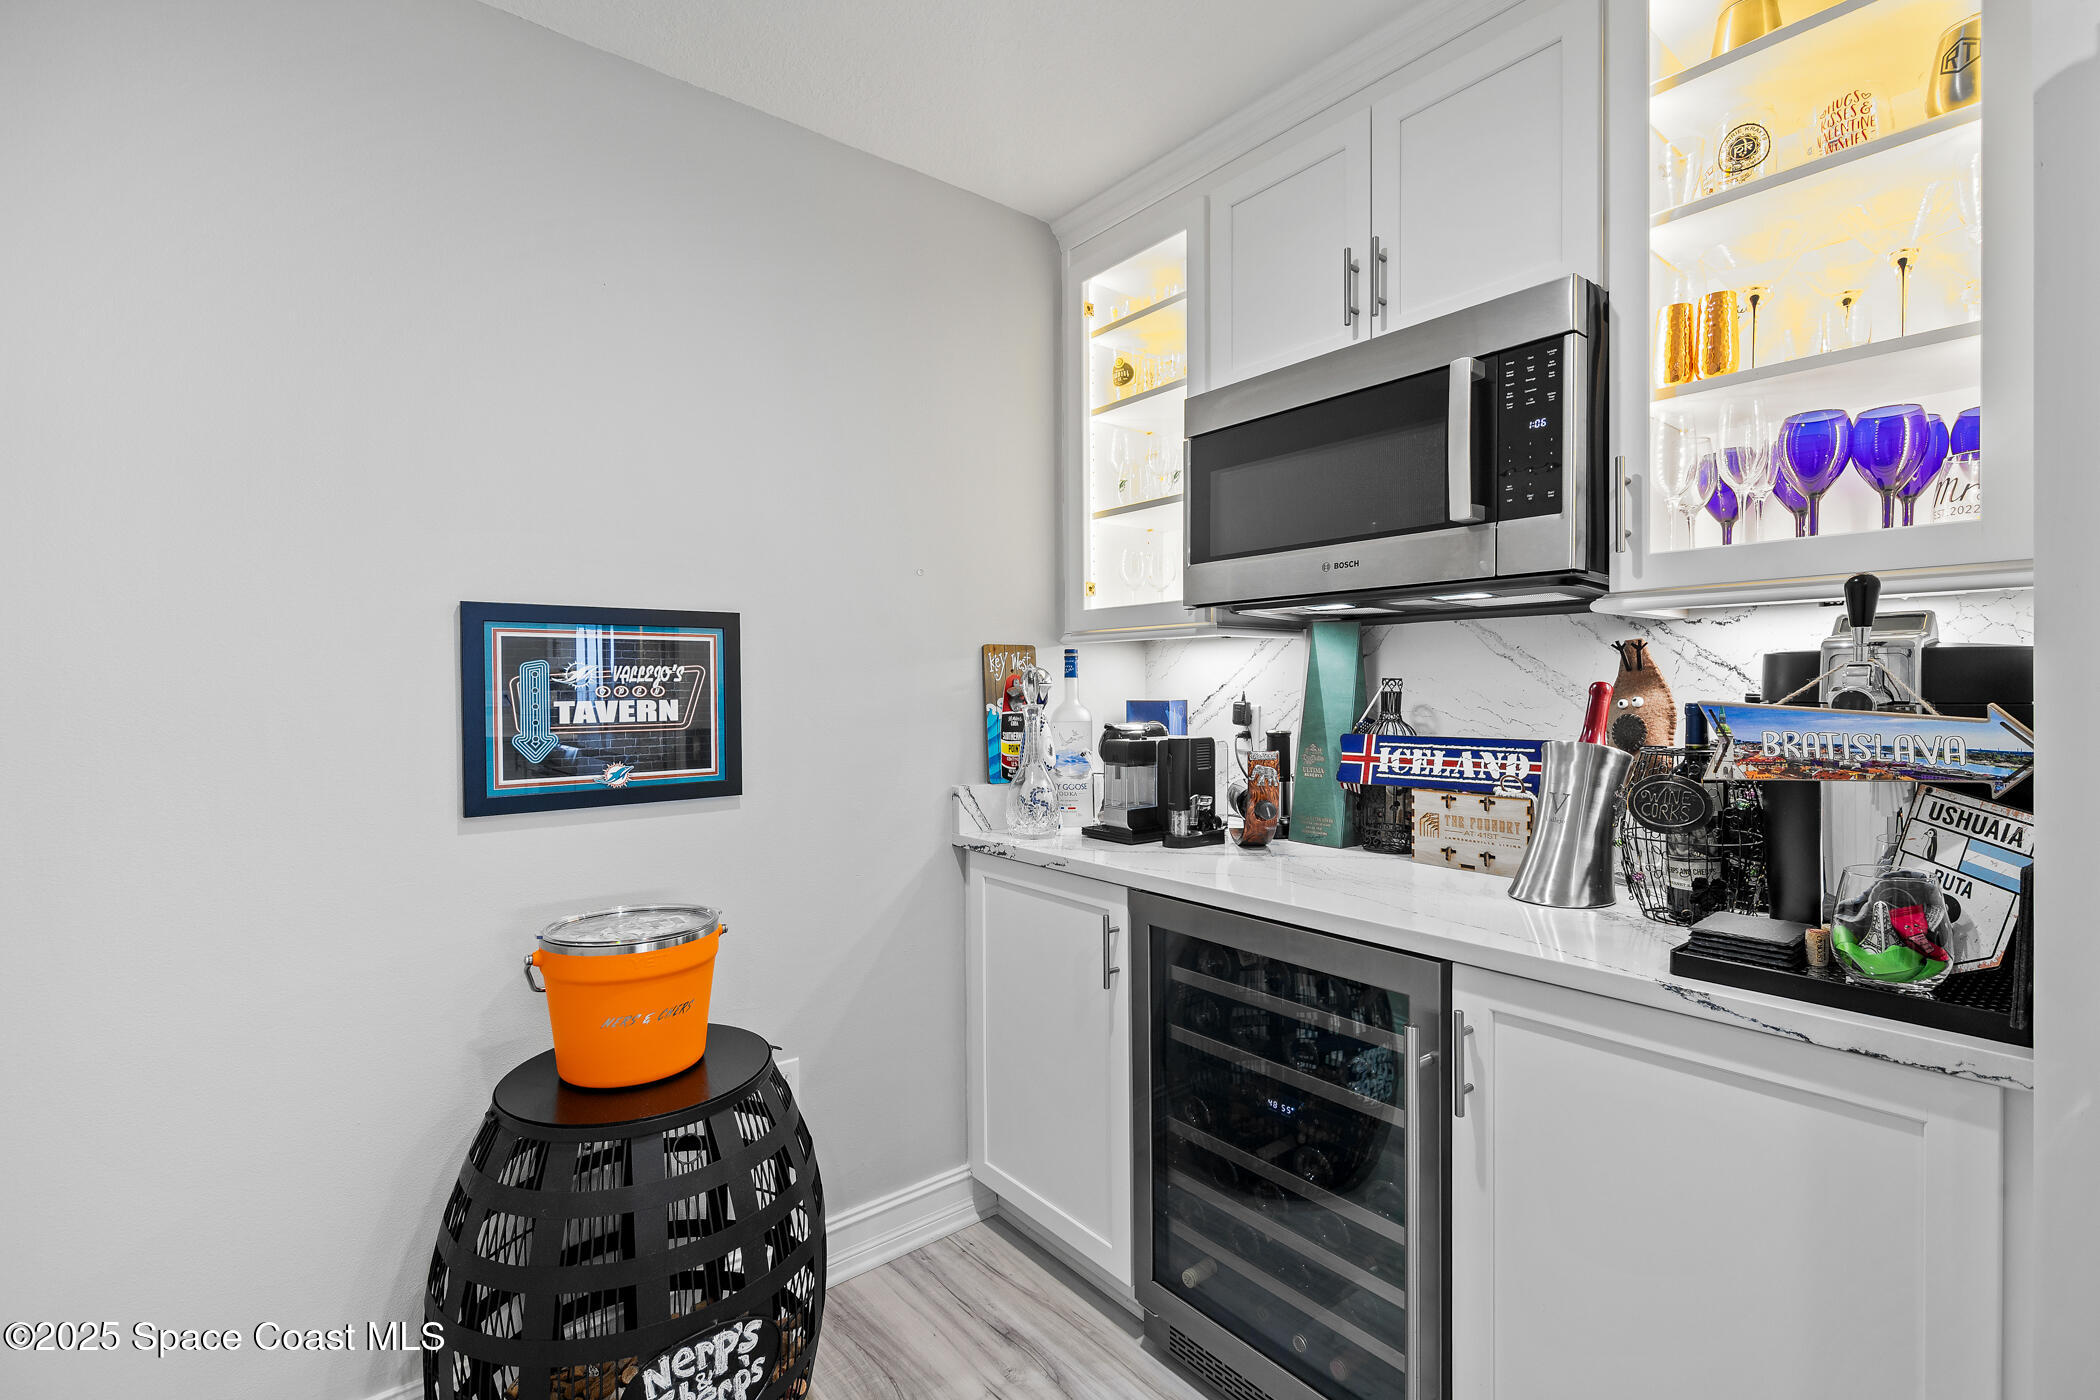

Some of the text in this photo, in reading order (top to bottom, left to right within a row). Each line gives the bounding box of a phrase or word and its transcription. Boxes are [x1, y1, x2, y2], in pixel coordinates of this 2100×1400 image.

[1822, 90, 1860, 117] HUGS
[1820, 101, 1873, 133] KISSES &
[1816, 115, 1877, 148] VALENTINE
[1824, 129, 1868, 155] WISHES
[1529, 417, 1547, 429] 1:06
[1950, 504, 1980, 516] 2022
[1333, 560, 1360, 570] BOSCH
[613, 664, 685, 688] VALLEJO'S
[553, 699, 679, 725] TAVERN
[1761, 730, 1968, 767] BRATISLAVA
[1378, 747, 1531, 781] ICELAND
[1640, 785, 1692, 805] WINE
[1444, 814, 1521, 835] THE FOUNDRY
[1641, 802, 1690, 822] CORKS
[1928, 801, 2027, 849] USHUAIA
[1935, 868, 1974, 900] RUTA
[1267, 1099, 1278, 1109] 48
[642, 1319, 763, 1400] Nerp's
[695, 1369, 715, 1391] &
